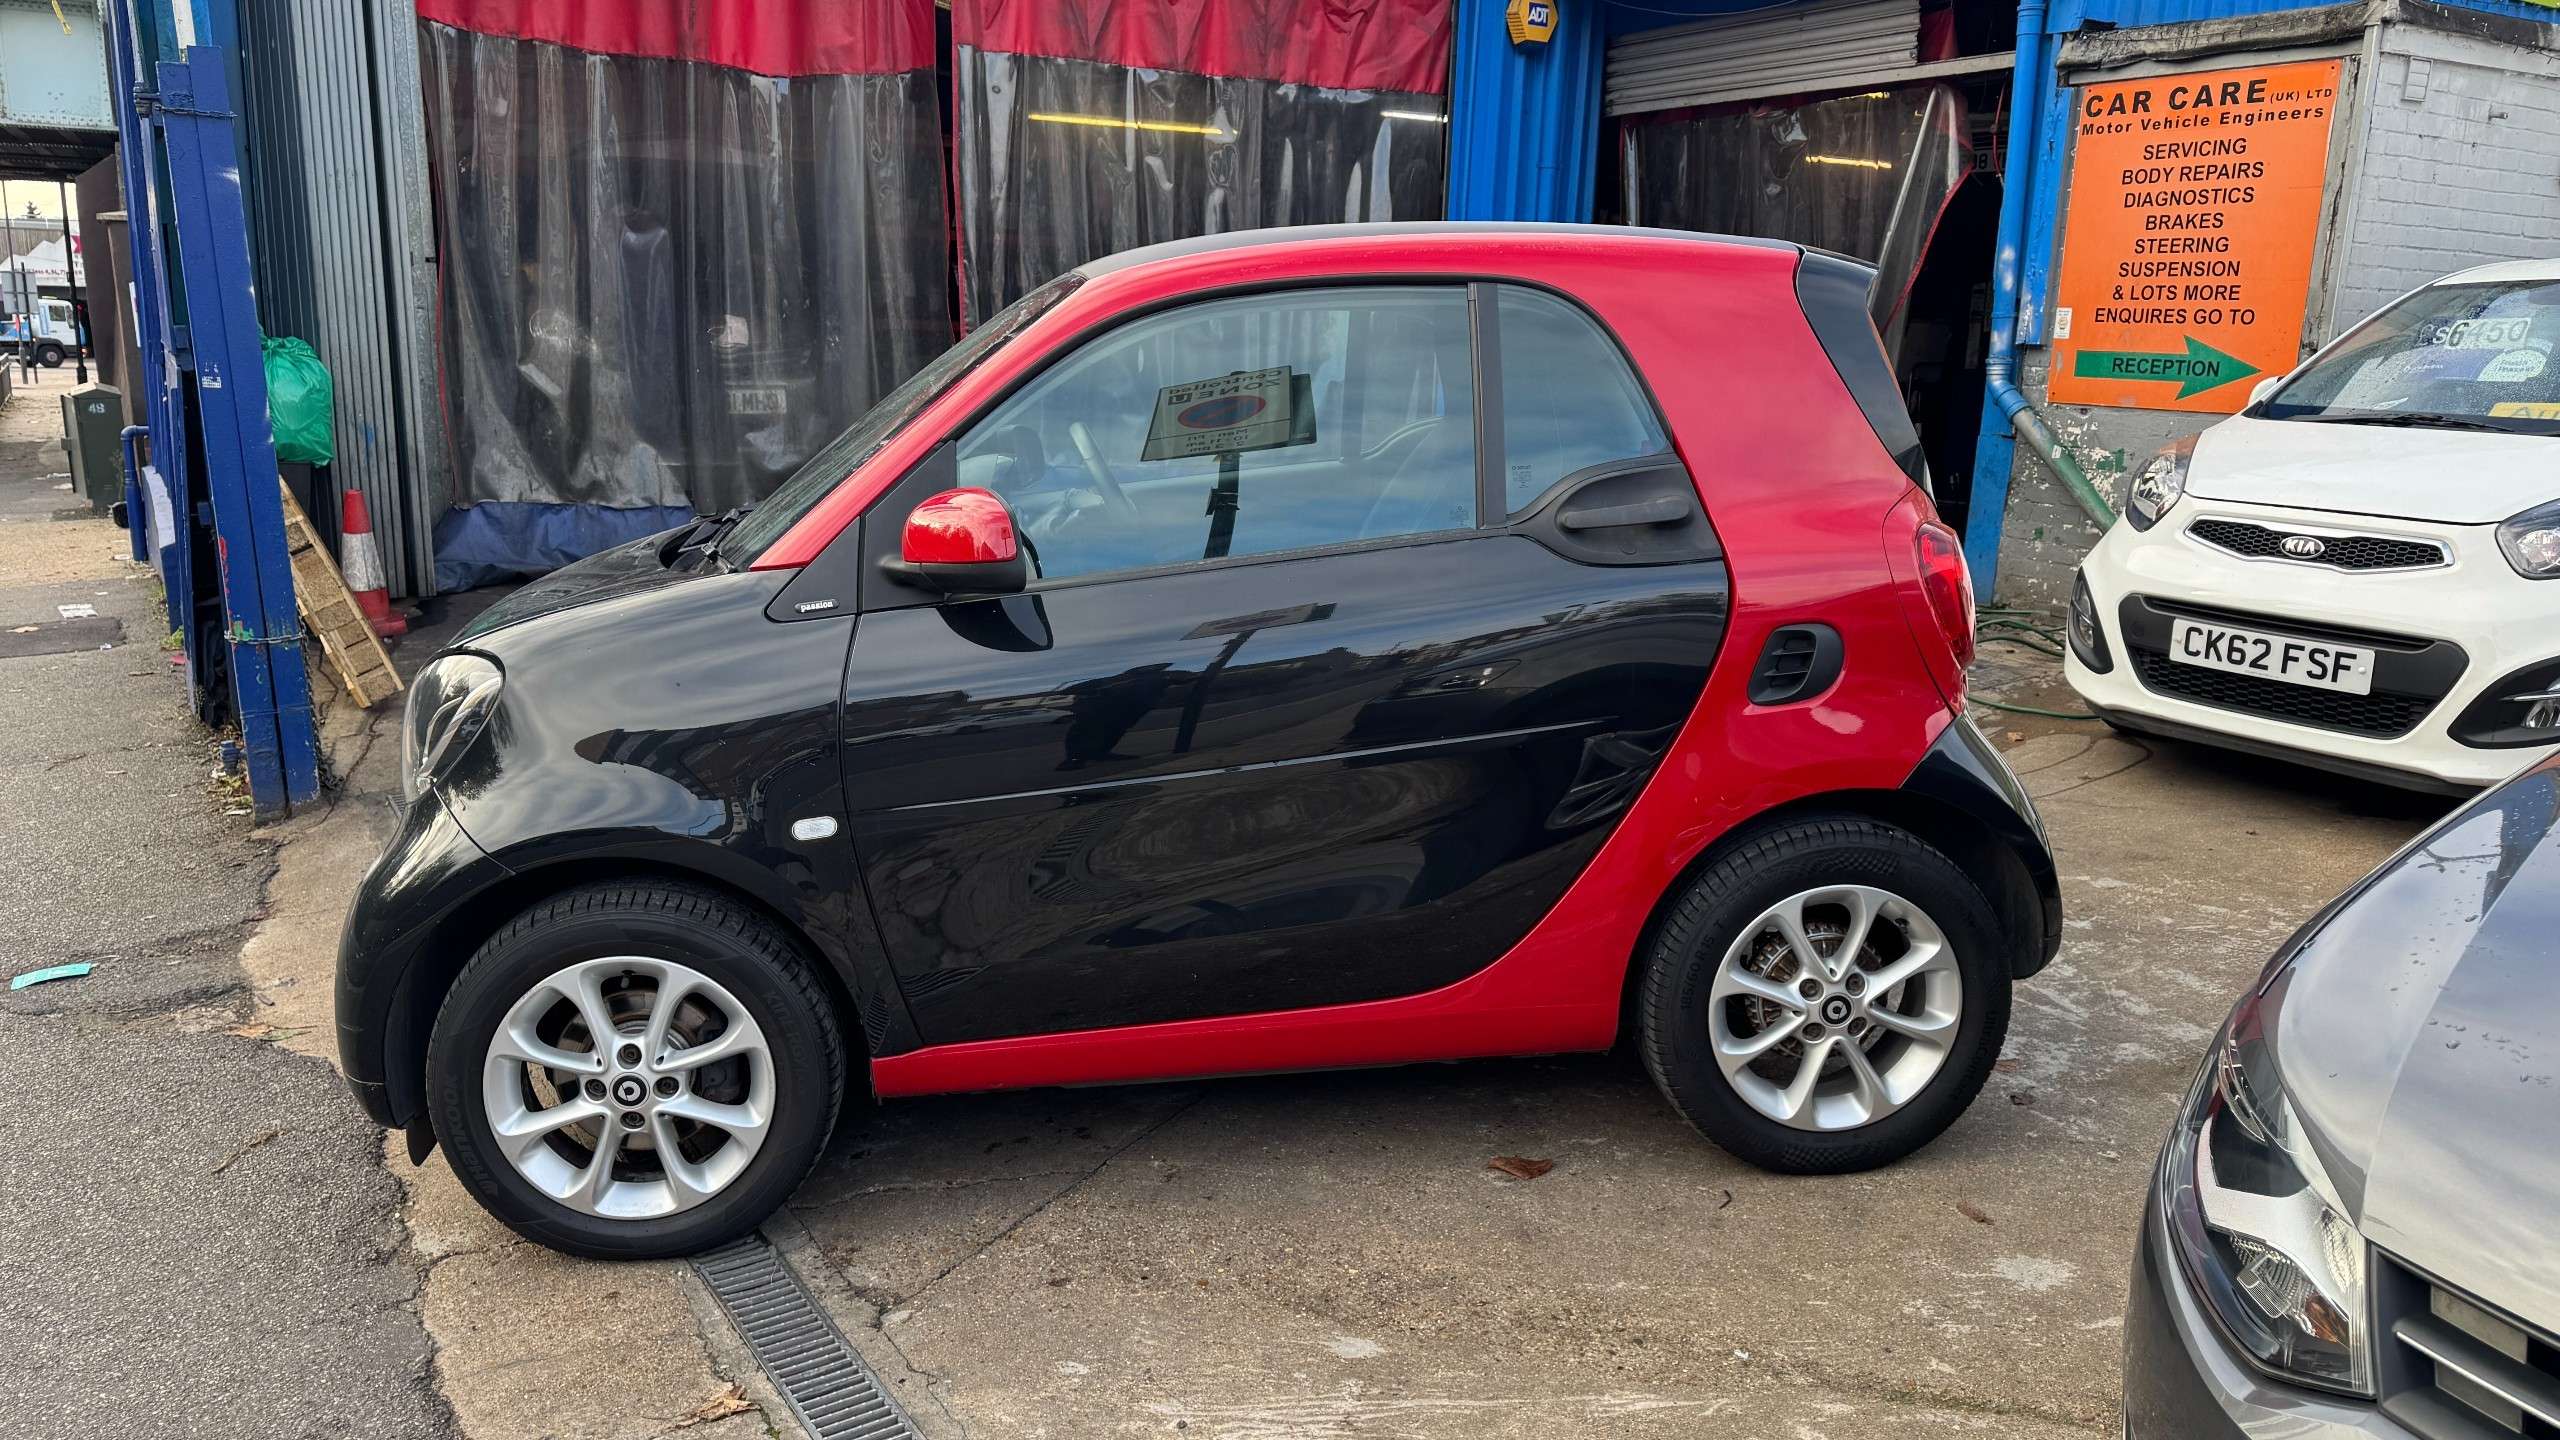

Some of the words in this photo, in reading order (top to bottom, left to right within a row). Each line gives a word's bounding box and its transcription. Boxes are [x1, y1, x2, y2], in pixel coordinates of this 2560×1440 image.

[1528, 6, 1550, 24] ADT
[2086, 90, 2152, 118] CAR
[2169, 79, 2267, 110] CARE
[2270, 91, 2300, 103] (UK)
[2306, 88, 2333, 99] LTD
[2081, 121, 2132, 136] Motor
[2141, 115, 2210, 131] Vehicle
[2219, 107, 2324, 126] Engineers
[2143, 138, 2247, 161] SERVICING
[2121, 166, 2174, 186] BODY
[2179, 161, 2265, 182] REPAIRS
[2123, 187, 2255, 209] DIAGNOSTICS
[2145, 212, 2224, 231] BRAKES
[2134, 236, 2230, 255] STEERING
[2118, 260, 2241, 278] SUSPENSION
[2112, 285, 2124, 301] &
[2130, 284, 2177, 301] LOTS
[2183, 284, 2241, 301] MORE
[2094, 308, 2187, 325] ENQUIRES
[2193, 308, 2223, 325] GO
[2229, 308, 2255, 326] TO
[2112, 357, 2220, 378] RECEPTION
[88, 402, 105, 414] 48
[2284, 541, 2316, 554] KIA
[800, 600, 834, 613] passion
[2184, 626, 2272, 671] CK62
[2281, 642, 2357, 683] FSF
